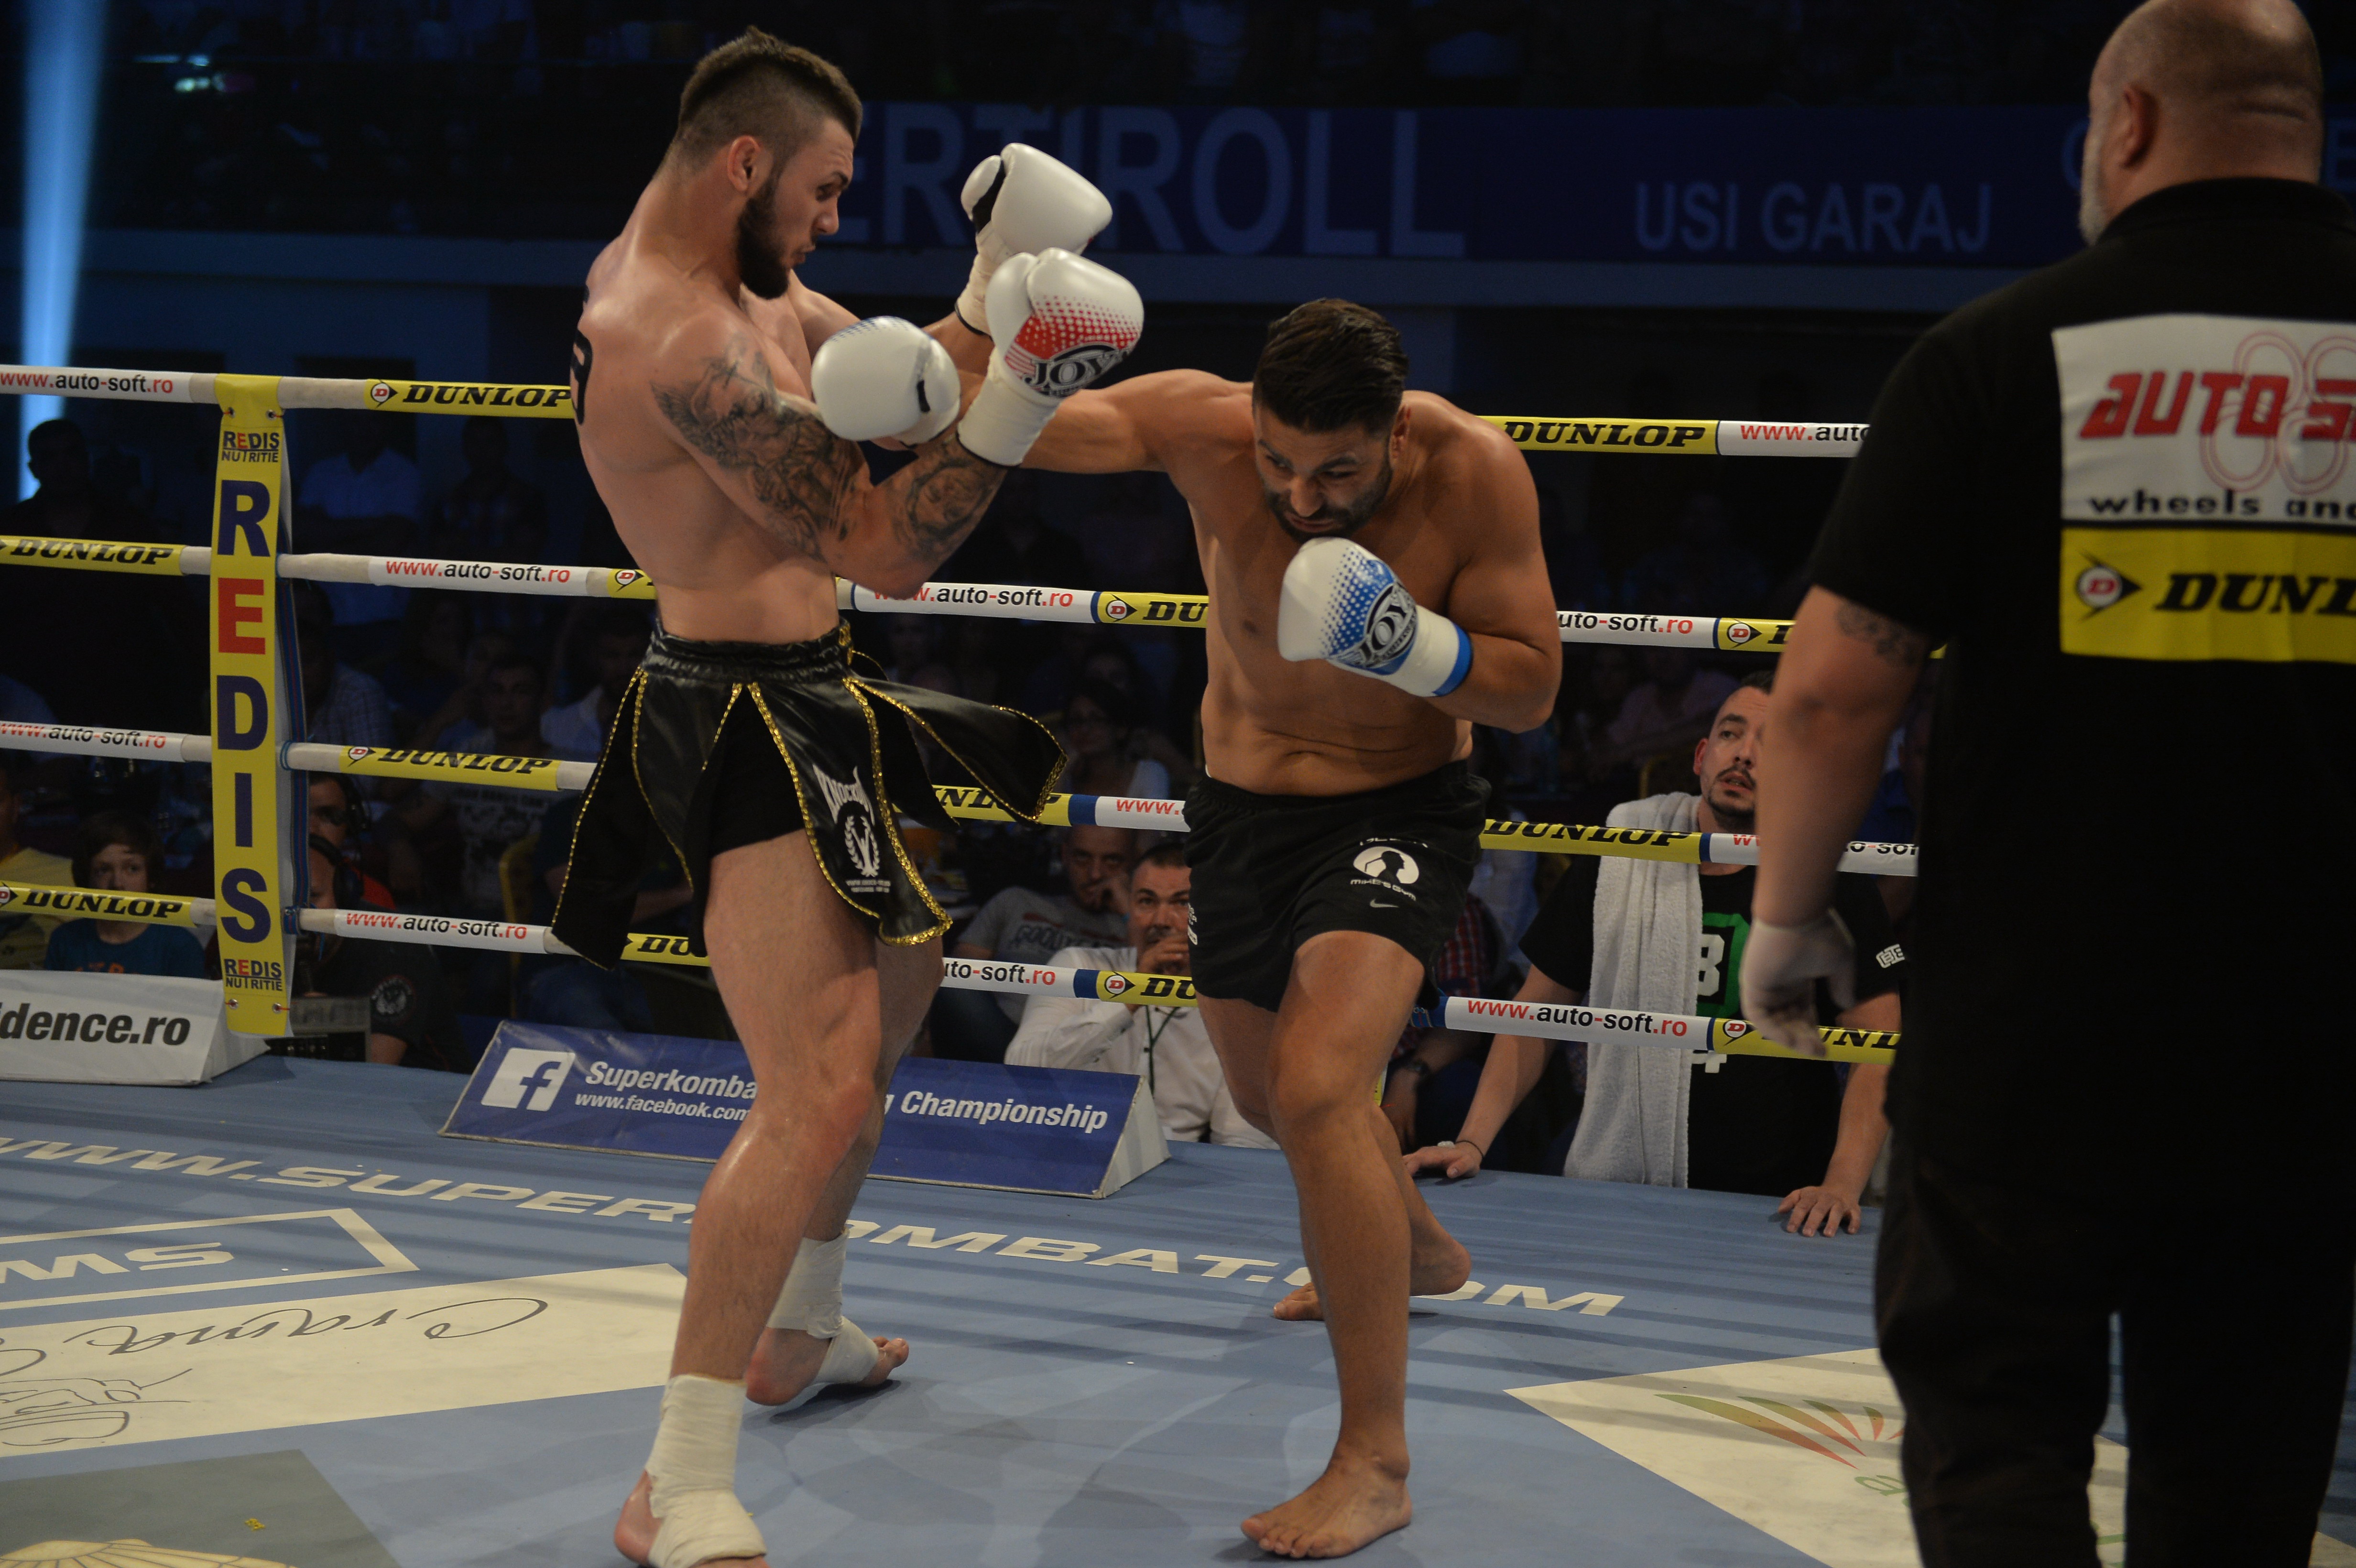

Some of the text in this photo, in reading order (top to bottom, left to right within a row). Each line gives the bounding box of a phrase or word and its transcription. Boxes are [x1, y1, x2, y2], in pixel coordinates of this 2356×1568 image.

[1634, 181, 1993, 254] USI GARAJ
[0, 372, 174, 393] www.auto-soft.ro
[403, 384, 571, 407] DUNLOP
[2080, 371, 2290, 439] AUTO
[223, 431, 280, 449] REDIS
[1504, 421, 1706, 448] DUNLOP
[221, 450, 278, 463] NUTRITIE
[2091, 489, 2259, 515] wheels
[11, 539, 174, 565] DUNLOP
[386, 561, 570, 584] www.auto-soft.ro
[217, 479, 271, 944] REDIS
[0, 723, 166, 749] www.auto-soft.ro
[378, 748, 552, 773] DUNLOP
[1483, 819, 1690, 847] DUNLOP
[23, 889, 183, 918] DUNLOP
[346, 913, 527, 940] www.auto-soft.ro
[224, 958, 282, 978] REDIS
[225, 978, 283, 991] NUTRITIE
[0, 1002, 190, 1045] dence.ro
[1467, 1000, 1687, 1036] www.auto-soft.ro
[900, 1090, 1108, 1134] Championship
